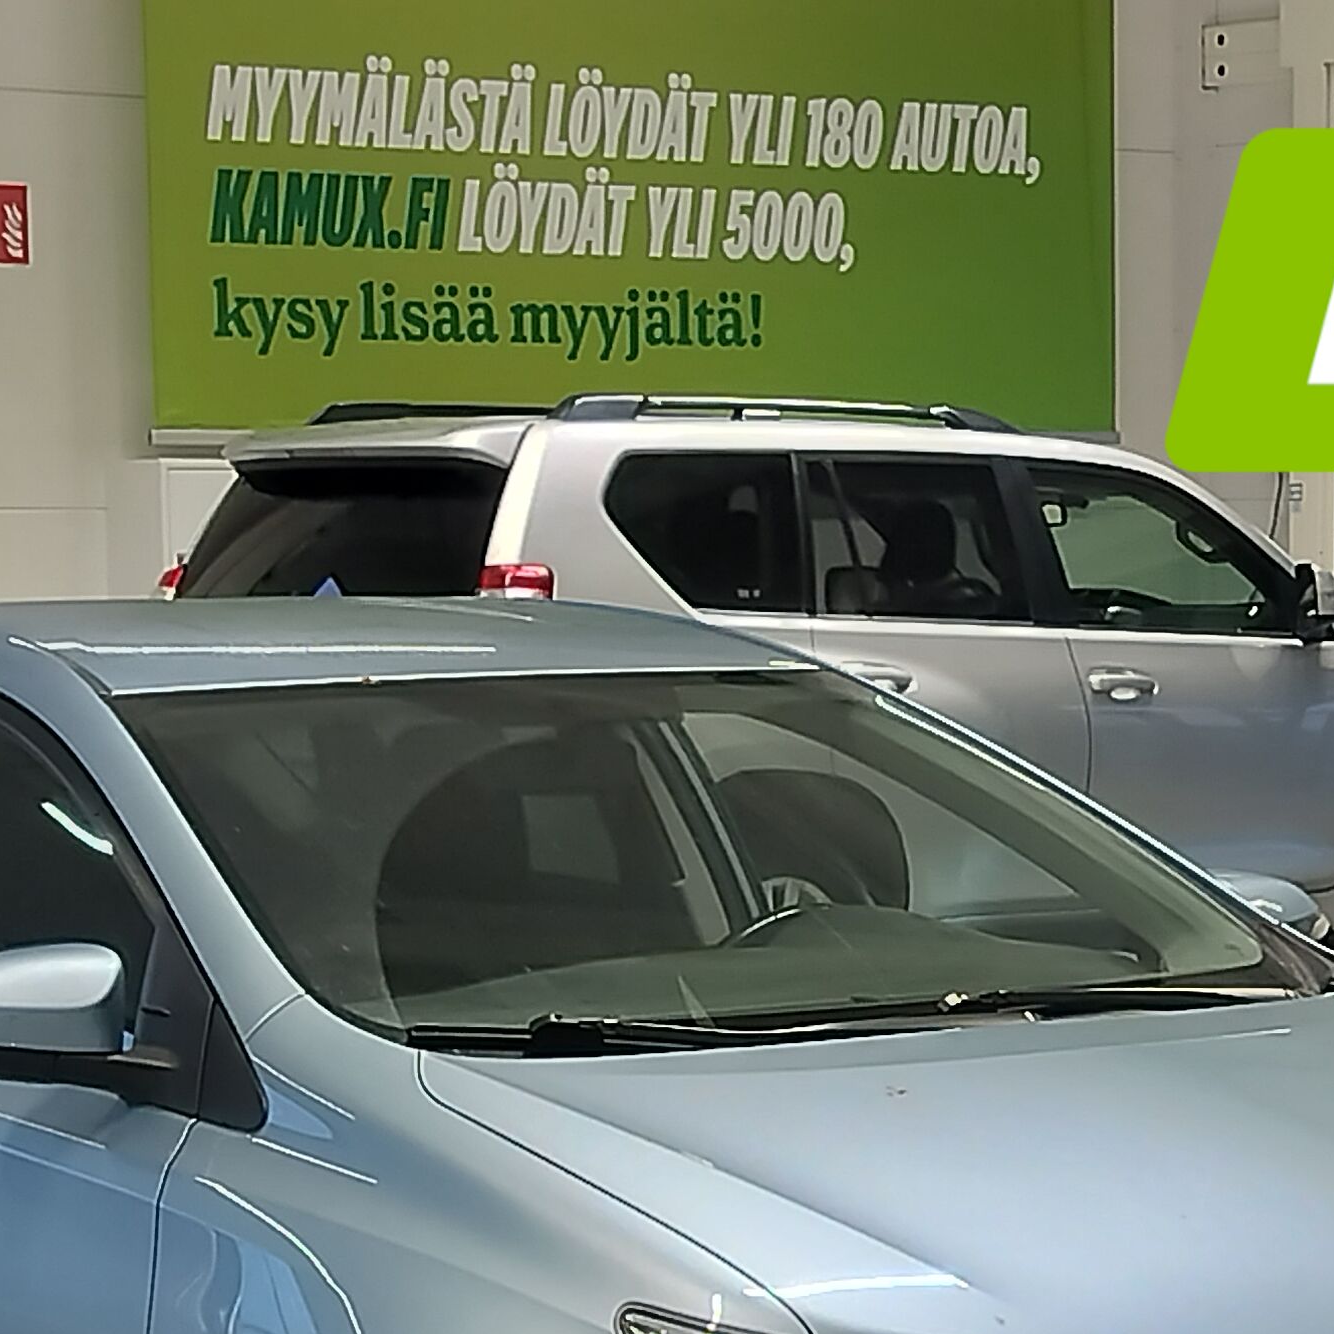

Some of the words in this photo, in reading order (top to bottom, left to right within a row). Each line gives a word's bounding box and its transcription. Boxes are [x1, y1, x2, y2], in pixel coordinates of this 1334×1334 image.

[206, 55, 536, 156] MYYMÄLÄSTÄ
[543, 67, 718, 162] LÖYDÄT
[729, 93, 796, 166] YLI
[805, 97, 884, 170] 180
[889, 102, 1041, 184] AUTOA,
[208, 167, 451, 251] KAMUX.FI
[457, 162, 636, 257] LÖYDÄT
[647, 185, 717, 259] YLI
[722, 188, 855, 272] 5000,
[212, 276, 349, 357] kysy
[359, 280, 499, 344] lisää
[510, 288, 763, 361] myyjältä!
